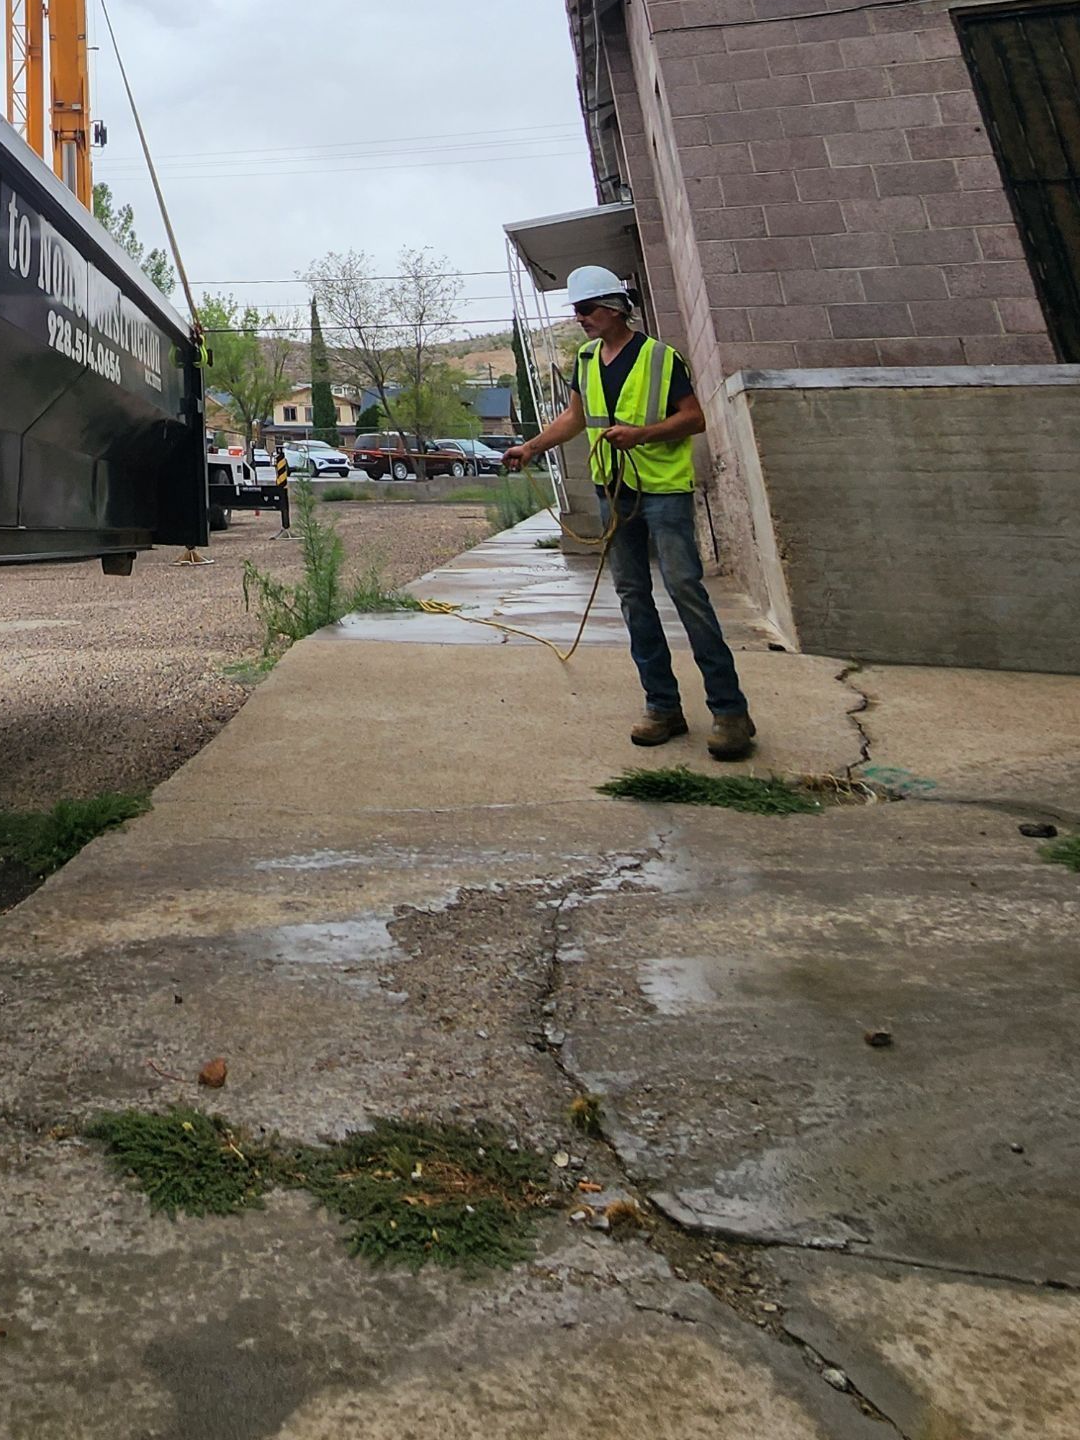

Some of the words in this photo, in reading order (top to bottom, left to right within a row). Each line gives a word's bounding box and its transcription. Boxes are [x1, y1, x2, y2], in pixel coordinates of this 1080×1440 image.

[9, 191, 31, 279] to
[38, 217, 84, 318] Non
[89, 268, 161, 375] nstruction
[47, 310, 121, 385] 928.514.0656
